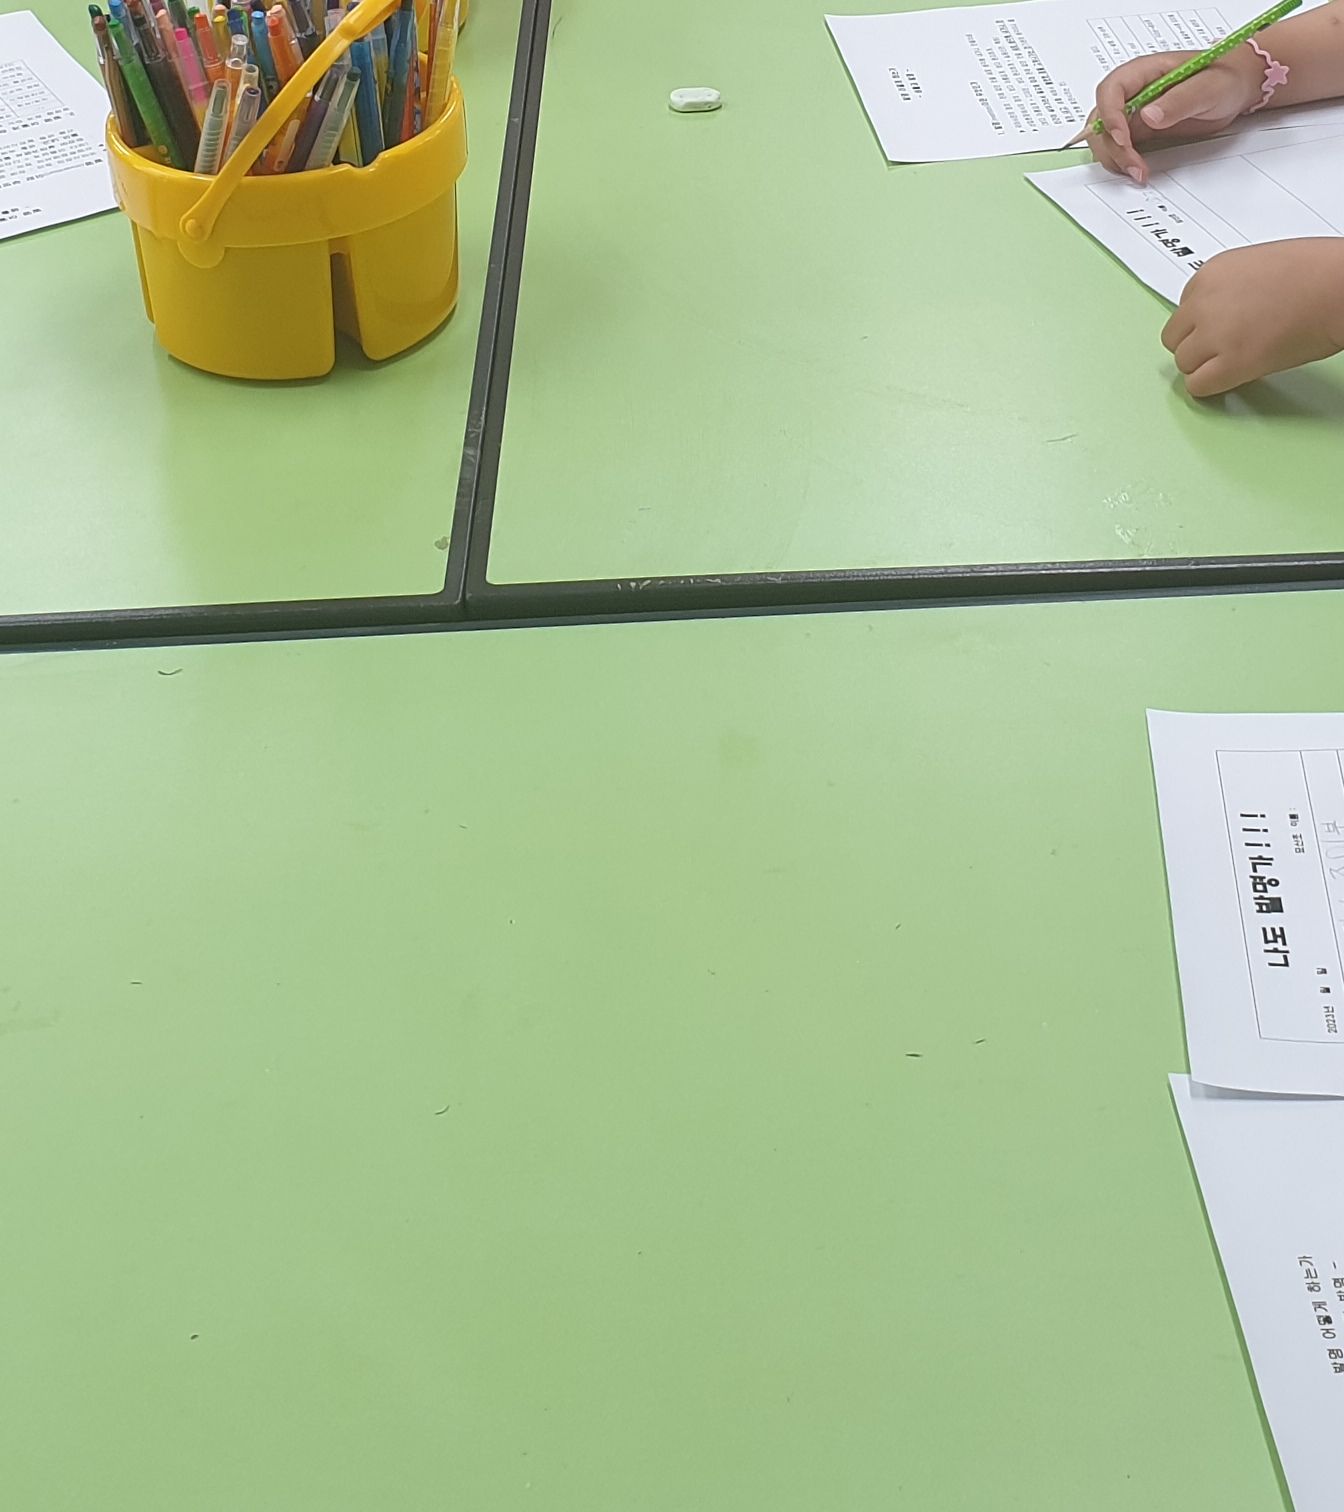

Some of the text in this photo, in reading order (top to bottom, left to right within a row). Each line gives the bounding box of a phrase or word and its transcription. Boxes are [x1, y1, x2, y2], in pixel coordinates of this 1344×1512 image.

[1261, 926, 1289, 967] 나도
[1297, 1255, 1321, 1292] 하는가
[1311, 1300, 1336, 1339] 어떻게
